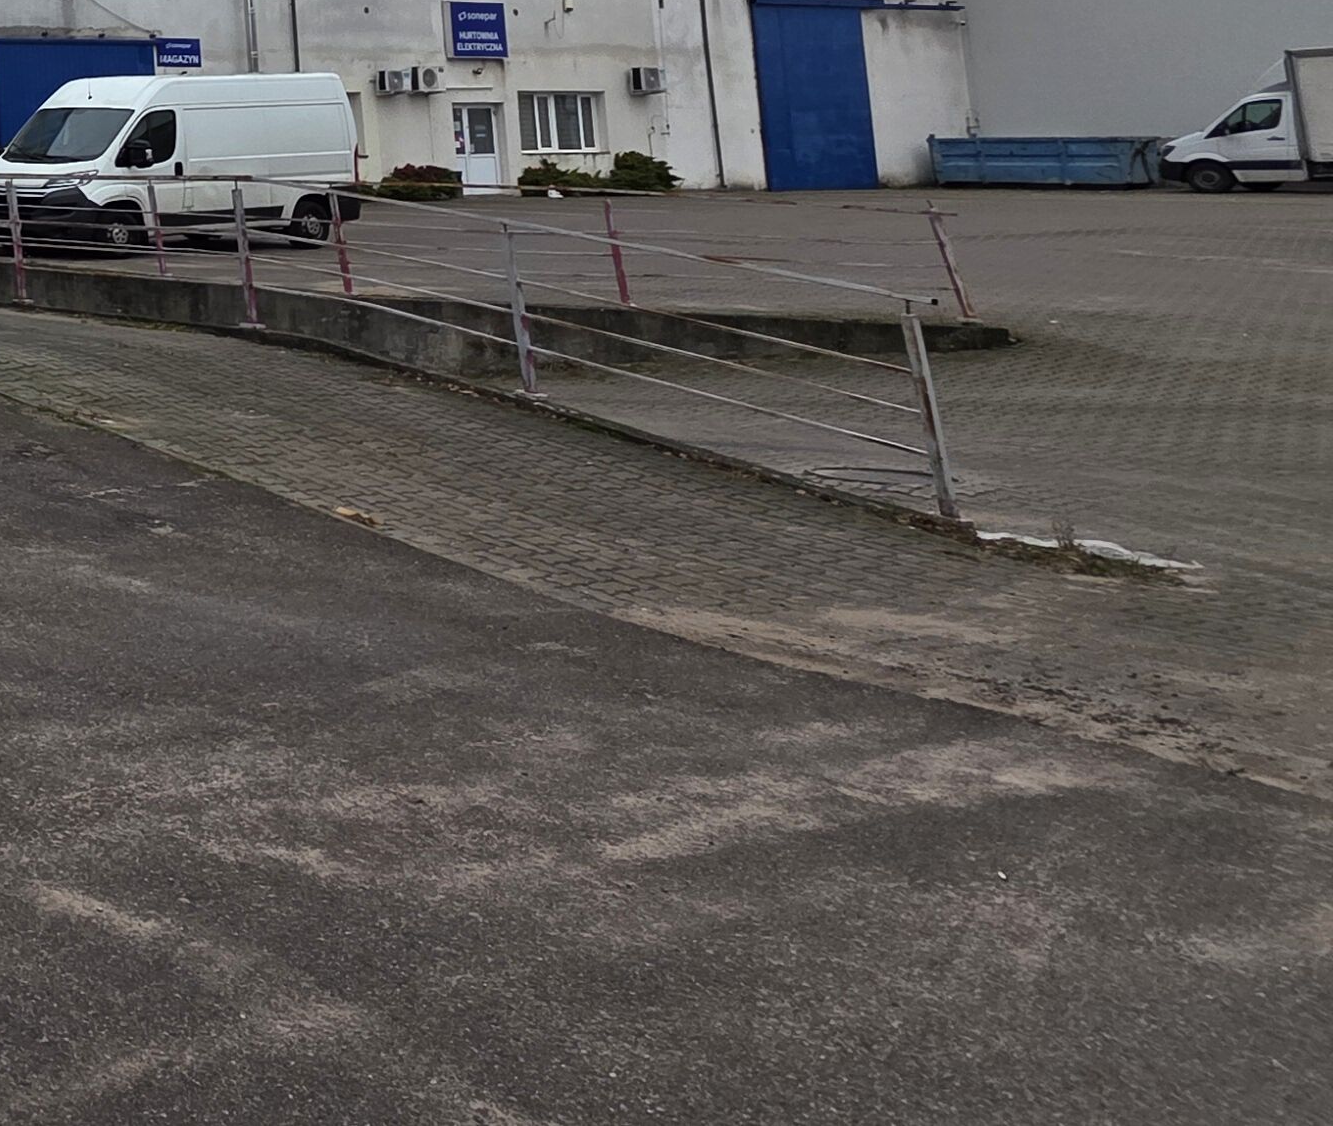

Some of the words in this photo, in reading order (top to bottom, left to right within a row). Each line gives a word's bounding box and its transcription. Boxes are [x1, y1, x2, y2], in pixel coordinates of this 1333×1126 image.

[468, 12, 497, 22] sonepar
[459, 32, 499, 40] HURTOWNIA
[457, 42, 503, 51] ELEKTRYCZNA
[159, 55, 199, 64] MAGAZYN
